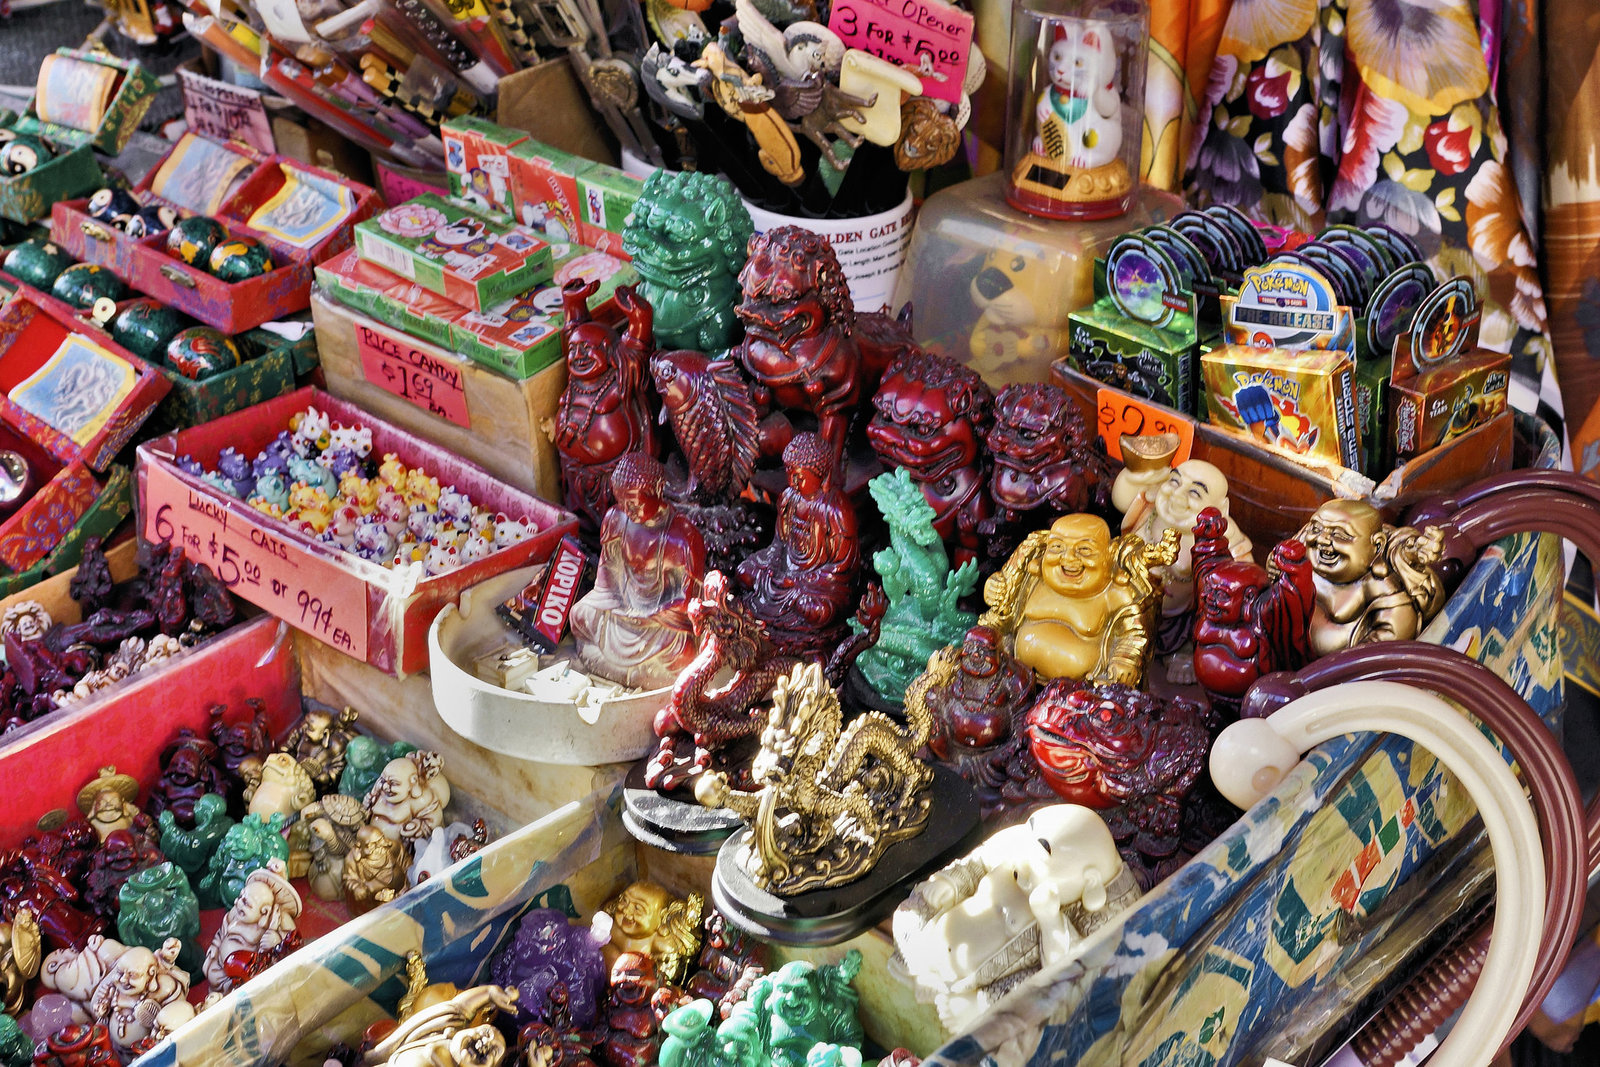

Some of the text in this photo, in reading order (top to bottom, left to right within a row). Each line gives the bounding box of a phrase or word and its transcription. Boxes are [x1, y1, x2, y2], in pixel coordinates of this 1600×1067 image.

[837, 6, 858, 36] 3
[902, 0, 965, 36] Opener
[870, 221, 897, 238] GATE
[1236, 306, 1333, 331] PRE-RELEASE
[361, 327, 458, 388] RICE CANDY
[382, 362, 433, 399] $1.69
[250, 528, 288, 560] CATS
[155, 503, 175, 541] 6
[208, 532, 261, 587] $5.00
[297, 589, 333, 634] 99¢
[332, 627, 356, 651] EA.
[541, 549, 582, 626] KOPIKO
